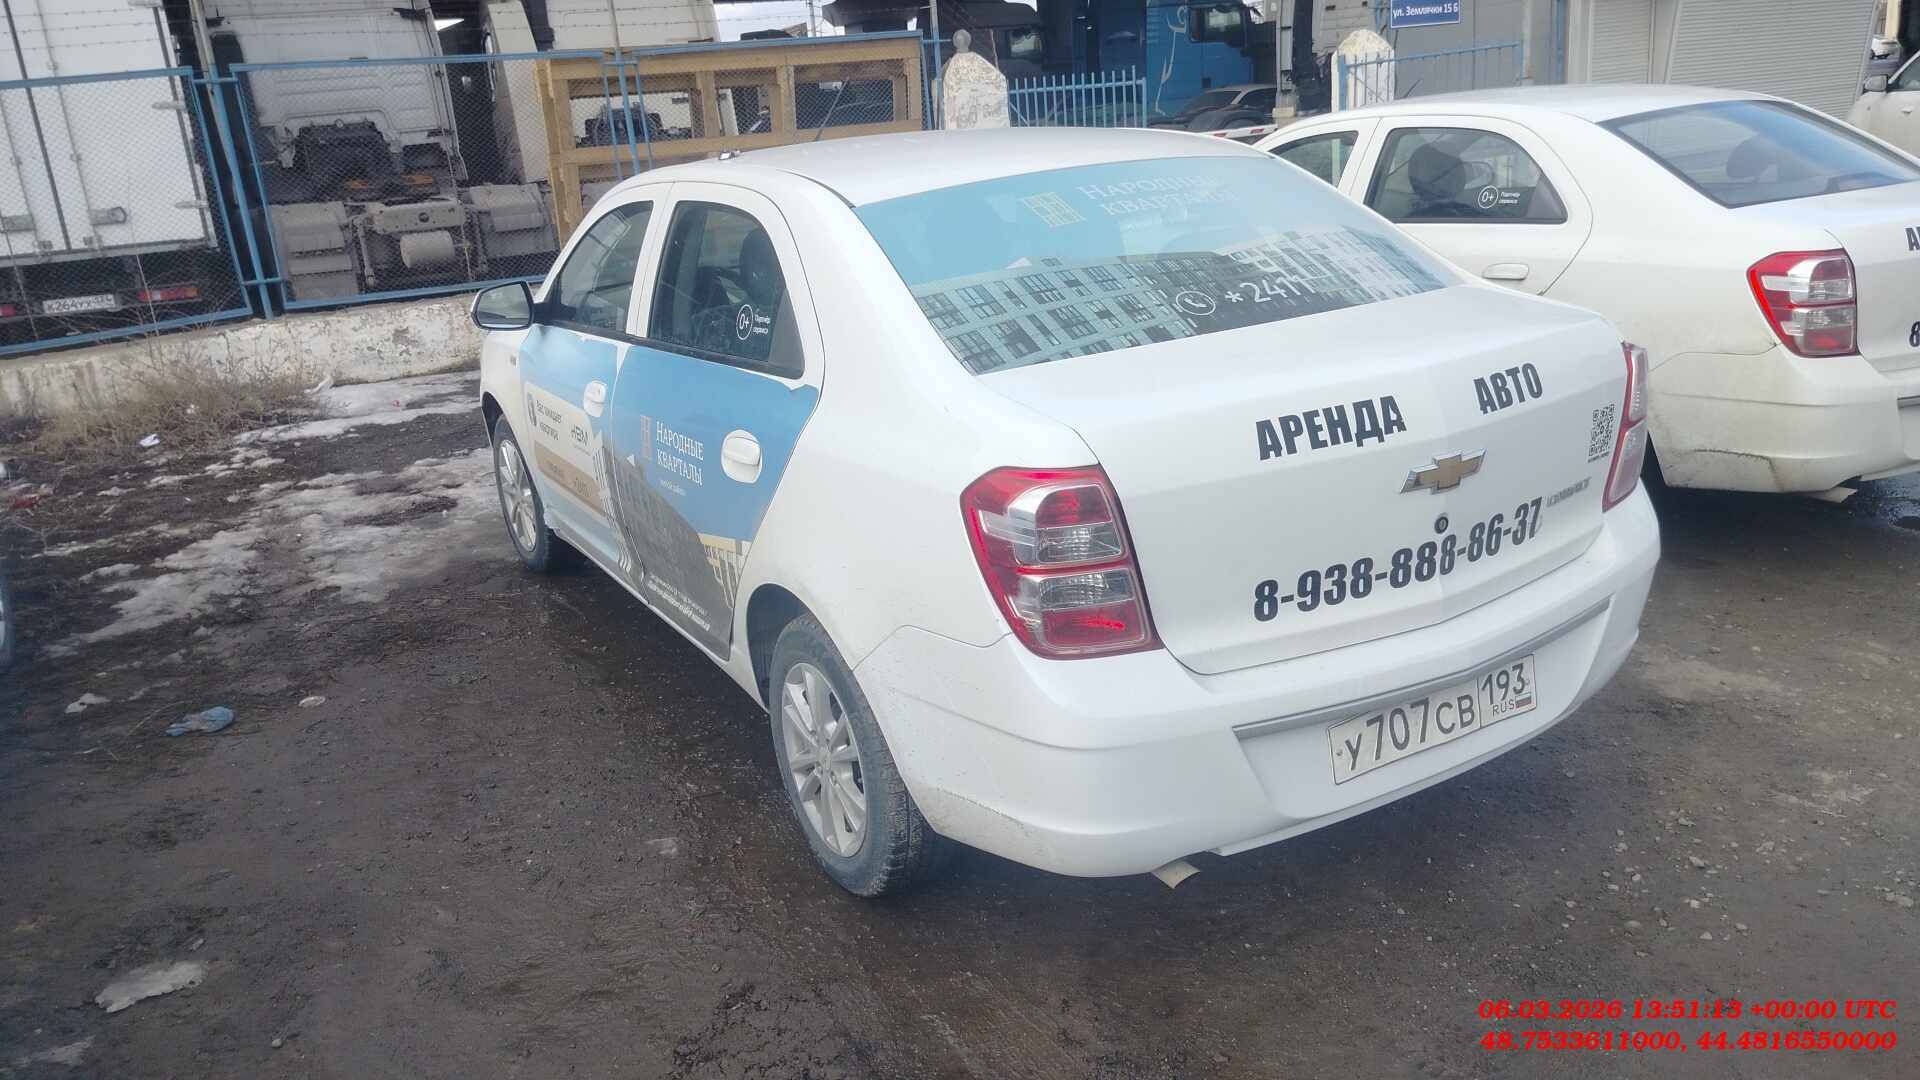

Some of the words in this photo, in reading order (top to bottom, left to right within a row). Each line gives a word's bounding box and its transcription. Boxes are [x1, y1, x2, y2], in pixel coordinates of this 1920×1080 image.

[1393, 8, 1404, 19] ул.
[1443, 3, 1453, 13] 15
[1481, 191, 1495, 203] 0+
[740, 313, 750, 330] 0+
[1255, 395, 1407, 461] АРЕНДА
[1473, 362, 1543, 415] АВТО
[1253, 496, 1543, 622] 8-938-888-86-37
[1345, 694, 1475, 770] У707СВ
[1481, 662, 1526, 705] 193
[1492, 700, 1515, 717] RUS
